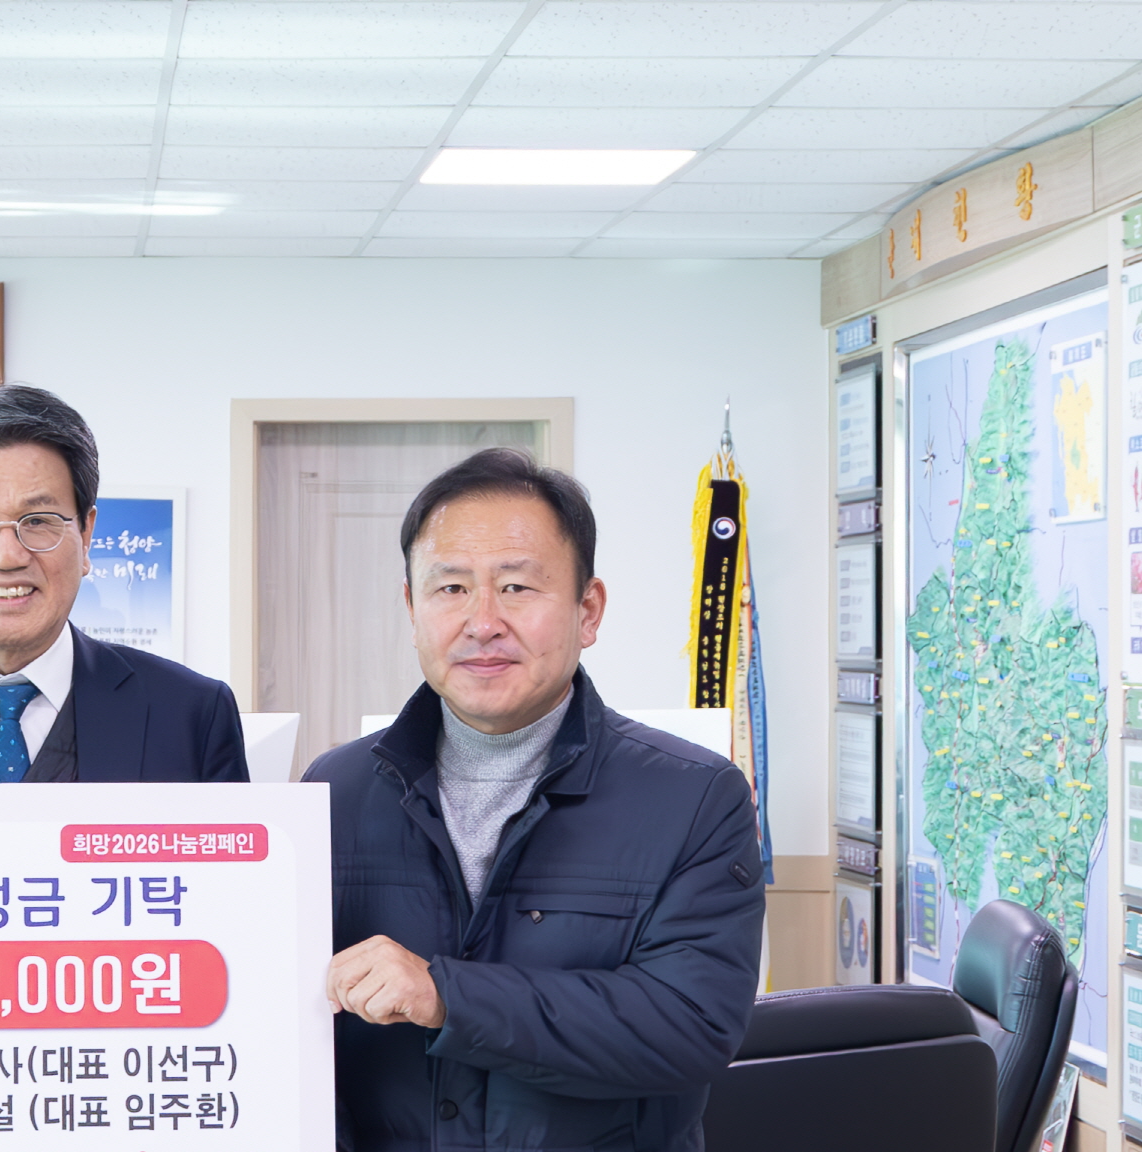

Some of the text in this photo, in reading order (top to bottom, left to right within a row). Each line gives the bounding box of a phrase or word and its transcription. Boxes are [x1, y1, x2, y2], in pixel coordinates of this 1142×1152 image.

[90, 529, 163, 556] 드는 청양
[113, 560, 159, 591] 미래
[72, 832, 254, 855] 희망2026나눔캠페인
[91, 875, 188, 928] 기탁
[123, 1043, 238, 1083] 이선구)
[29, 1092, 111, 1132] (대표
[125, 1091, 240, 1132] 임주환)
